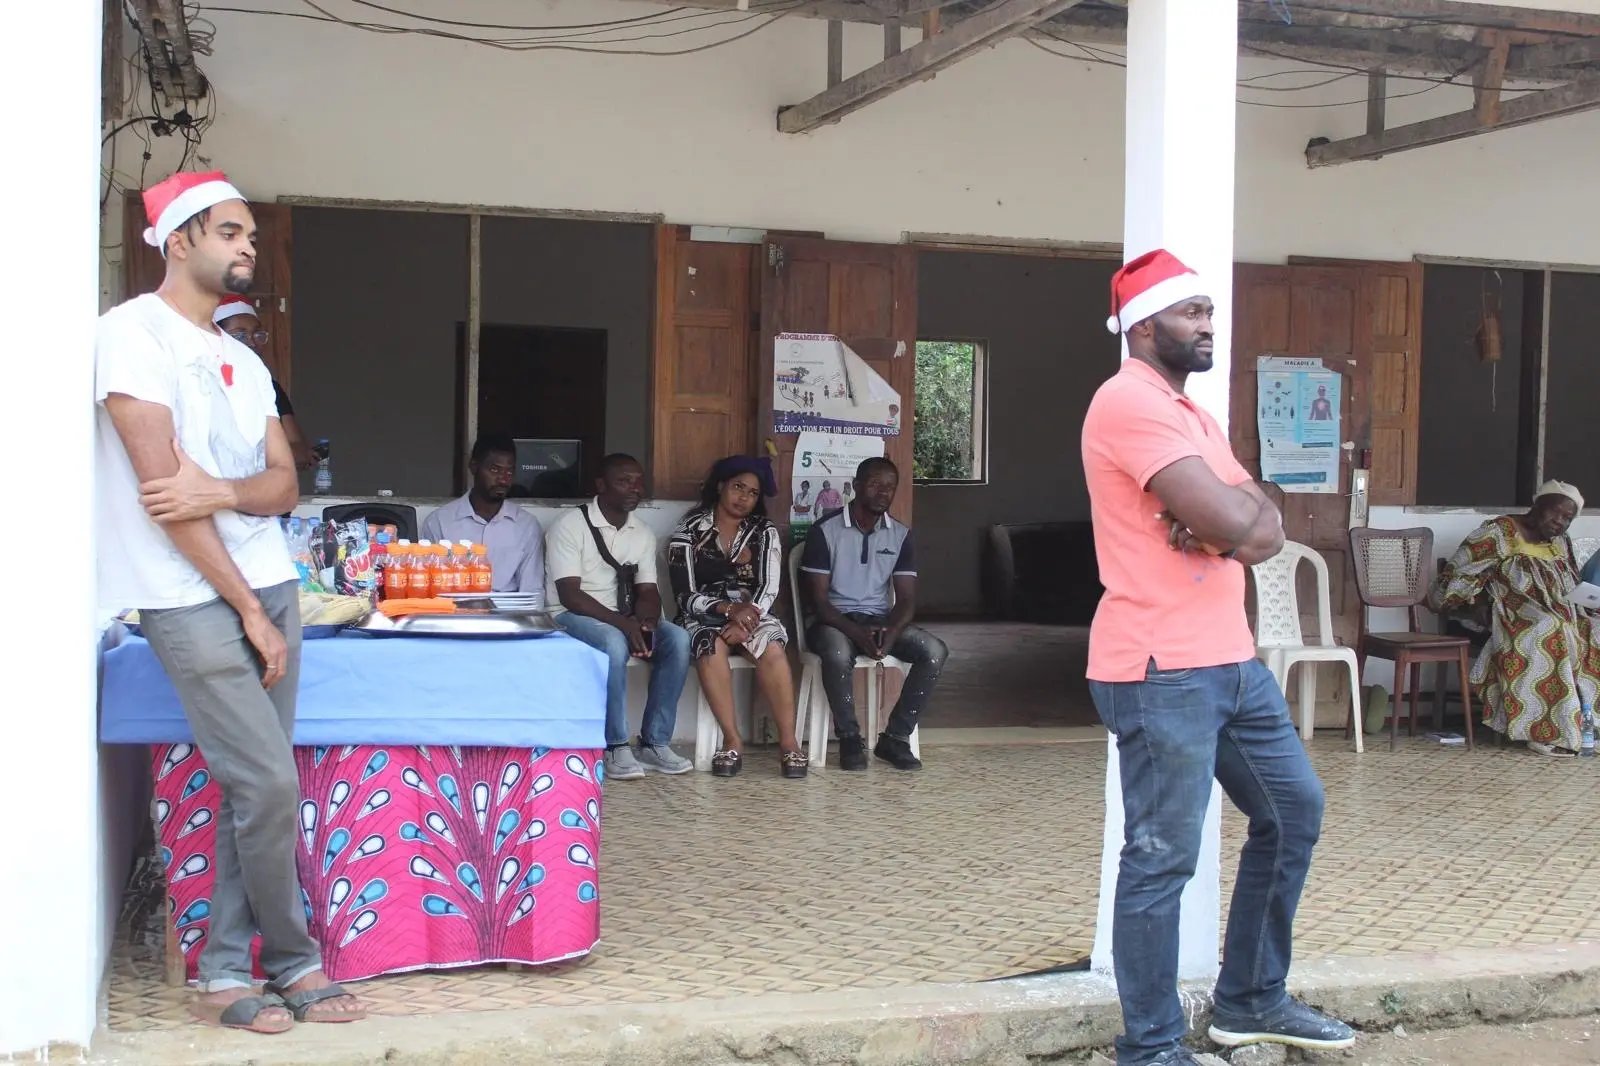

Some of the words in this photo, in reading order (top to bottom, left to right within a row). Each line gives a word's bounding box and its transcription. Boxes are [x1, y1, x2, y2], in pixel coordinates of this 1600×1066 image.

[775, 333, 819, 341] PROGRAMME
[819, 426, 832, 434] EST
[833, 426, 842, 434] UN
[843, 426, 863, 435] DROIT
[864, 427, 882, 435] POUR
[882, 427, 899, 436] TOUS
